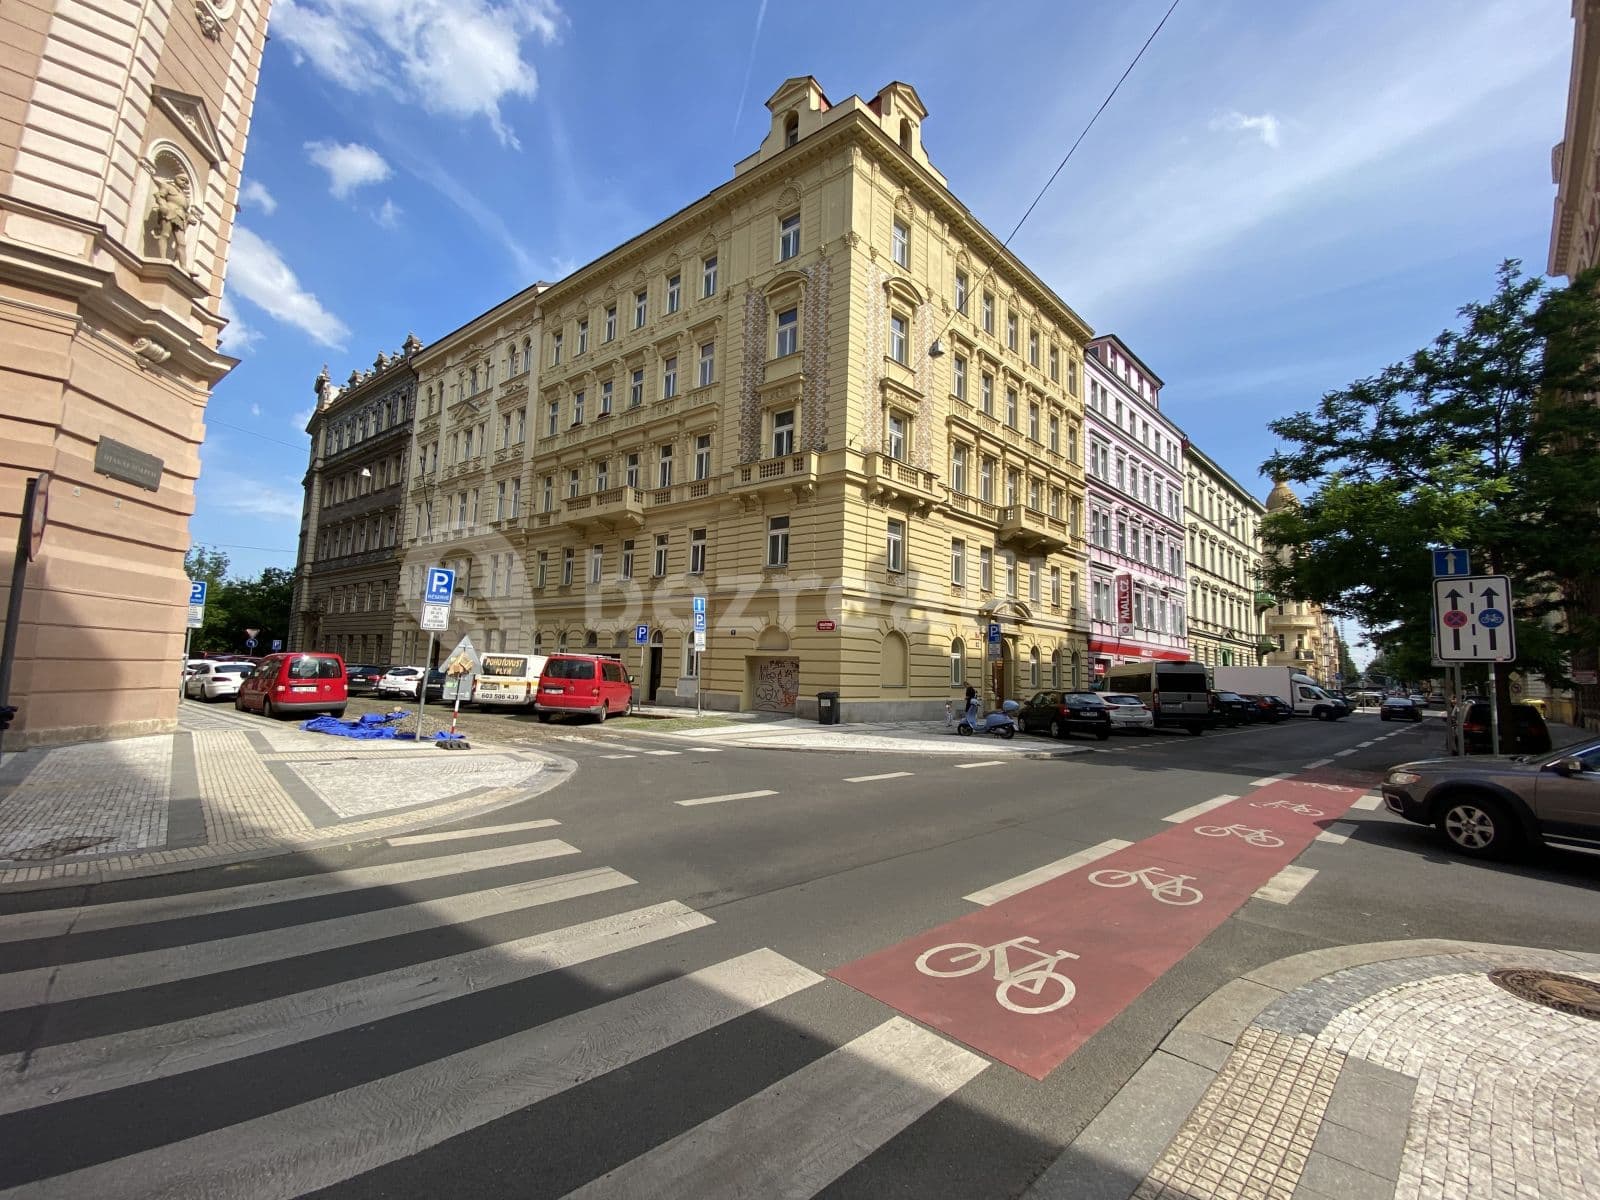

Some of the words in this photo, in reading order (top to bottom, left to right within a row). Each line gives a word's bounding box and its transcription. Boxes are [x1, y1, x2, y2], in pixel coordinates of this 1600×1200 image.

[432, 572, 449, 592] P
[1119, 579, 1130, 620] MALL.CZ
[638, 627, 647, 639] P
